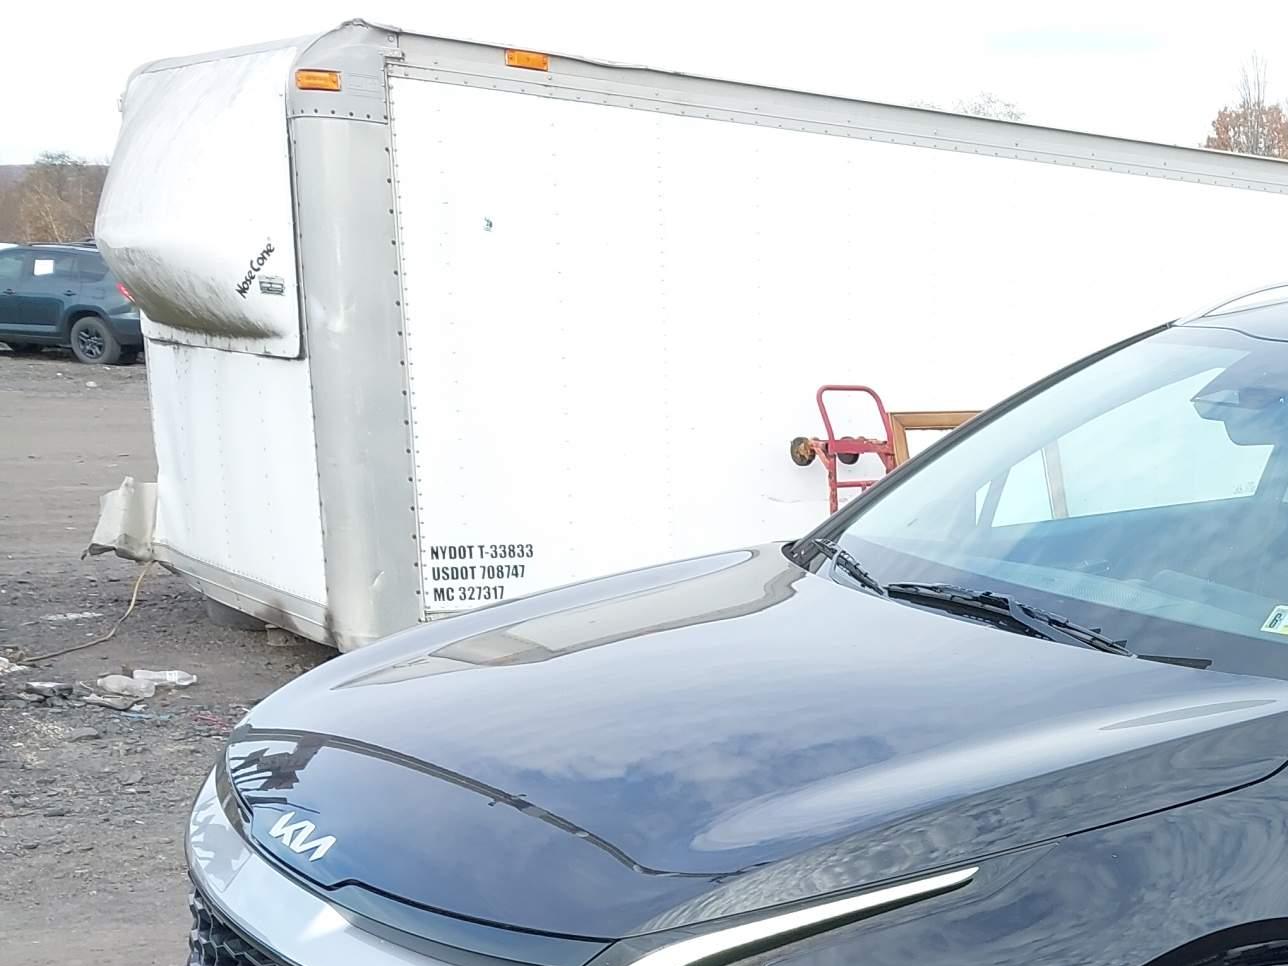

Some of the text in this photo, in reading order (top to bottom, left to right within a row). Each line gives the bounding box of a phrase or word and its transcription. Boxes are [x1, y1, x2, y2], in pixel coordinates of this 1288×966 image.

[430, 543, 534, 560] NYDOT T-33833
[432, 564, 526, 581] USDOT 708747
[433, 585, 505, 602] MC 327317
